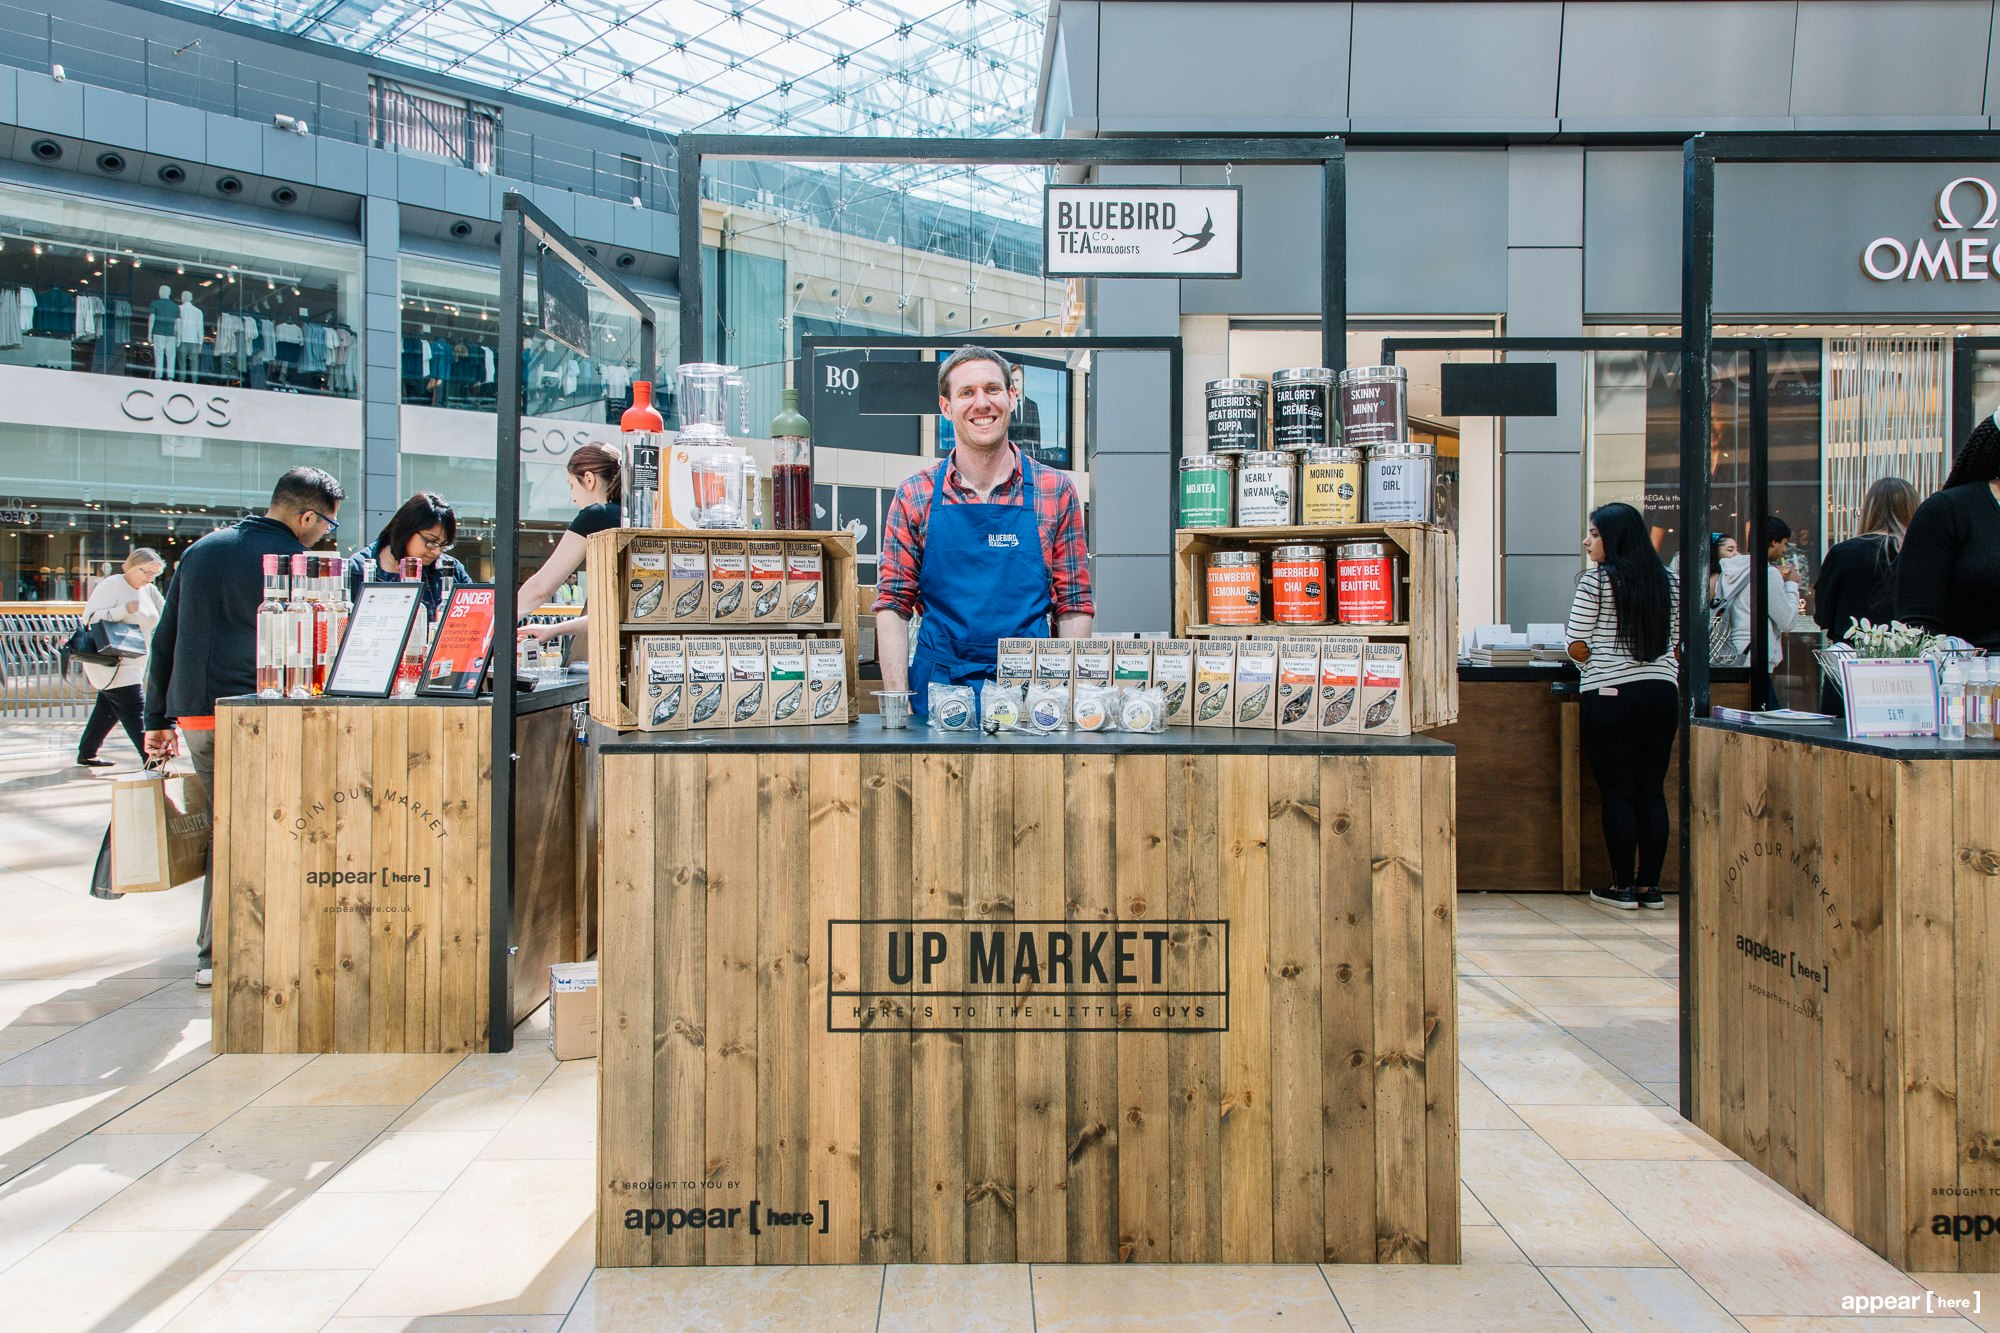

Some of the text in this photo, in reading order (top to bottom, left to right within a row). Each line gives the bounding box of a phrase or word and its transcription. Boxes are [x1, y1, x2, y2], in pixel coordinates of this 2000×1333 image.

[1059, 202, 1176, 230] BLUEBIRD
[1058, 232, 1115, 253] TEA Co.
[1093, 246, 1140, 254] MIXOLOGISTS
[1864, 237, 2000, 280] OME
[826, 365, 859, 390] BO
[1277, 389, 1316, 402] EARL GREY
[1350, 387, 1380, 400] SKINNY
[1211, 396, 1251, 408] BLUEBIRD'S
[121, 390, 231, 428] COS
[1282, 403, 1308, 416] CRÈME
[1352, 402, 1379, 415] MINNY
[1208, 408, 1257, 421] GREAT BRITISH
[1217, 421, 1242, 431] CUPPA
[1310, 469, 1344, 479] MORNING
[1381, 465, 1403, 476] DOZY
[1244, 472, 1273, 483] NEARLY
[1186, 483, 1216, 494] MOJITEA
[1316, 484, 1335, 493] KICK
[1382, 480, 1401, 491] GIRL
[1665, 494, 1671, 502] is
[631, 540, 664, 548] BLUEBIRD
[1340, 564, 1380, 576] HONEY BEE
[1208, 572, 1256, 583] STRAWBERRY
[1212, 586, 1250, 597] LEMONADE
[1284, 582, 1302, 592] CHAI
[1340, 580, 1381, 592] BEAUTIFUL
[456, 592, 492, 605] UNDER
[450, 605, 470, 618] 25?
[647, 643, 681, 651] BLUEBIRD
[688, 642, 721, 650] BLUEBIRD
[729, 642, 762, 650] BLUEBIRD
[770, 641, 802, 649] BLUEBIRD
[809, 640, 840, 649] BLUEBIRD
[1000, 641, 1032, 649] BLUEBIRD
[1038, 641, 1070, 649] BLUEBIRD
[1076, 641, 1109, 649] BLUEBIRD
[1116, 641, 1148, 649] BLUEBIRD
[1156, 642, 1189, 650] BLUEBIRD
[1240, 643, 1273, 651] BLUEBIRD
[1282, 644, 1315, 652] BLUEBIRD
[1324, 644, 1358, 653] BLUEBIRD
[1365, 645, 1400, 654] BLUEBIRD
[1871, 679, 1914, 693] ROSEWATER
[1888, 708, 1904, 720] £6.99
[289, 787, 448, 840] JOIN OUR MARKET
[170, 812, 210, 835] HOLLISTER
[306, 870, 377, 887] appear
[1724, 842, 1843, 931] JOIN OUR MARKET
[323, 905, 412, 913] appearhere.co.uk
[1736, 934, 1786, 969] appear
[888, 931, 1169, 985] UP MARKET
[853, 1006, 1206, 1018] HERE'S TO THE LITTLE GUYS
[625, 1181, 741, 1190] BROUGHT TO YOU BY
[1931, 1188, 1984, 1196] BROUGHT
[624, 1206, 741, 1236] appear
[1931, 1214, 2000, 1242] app
